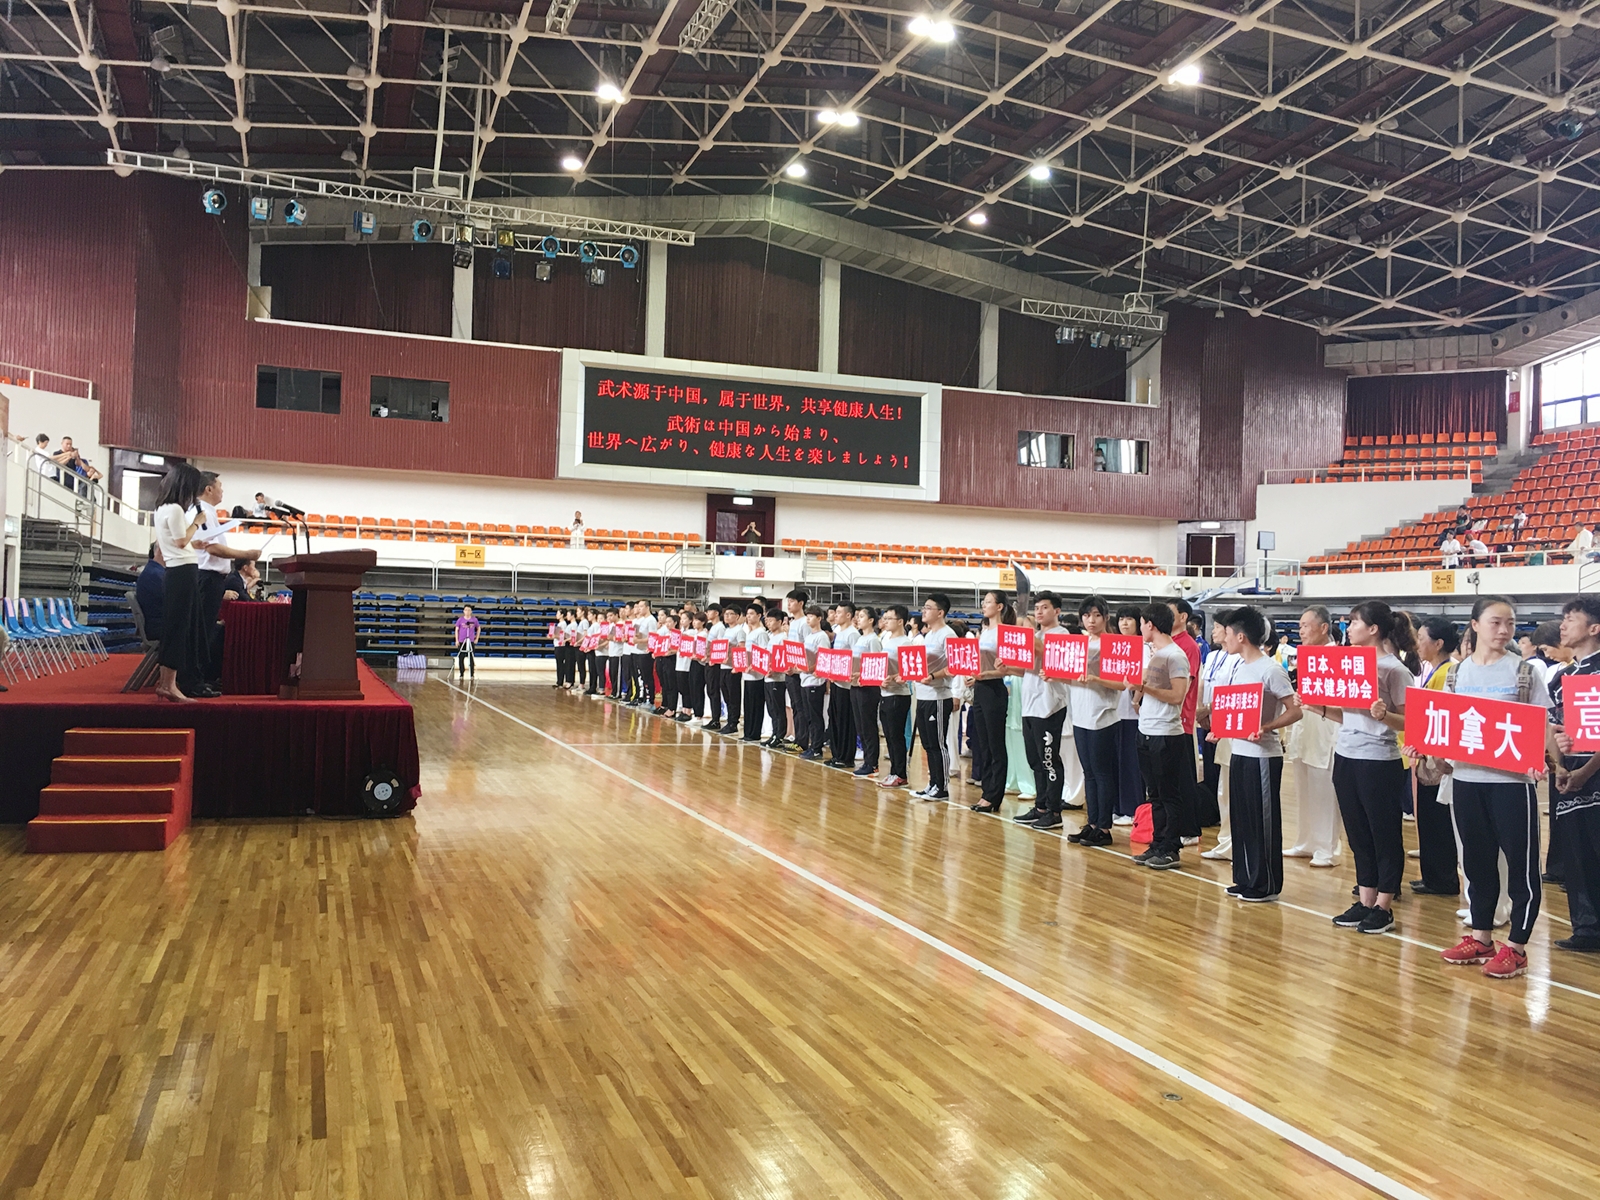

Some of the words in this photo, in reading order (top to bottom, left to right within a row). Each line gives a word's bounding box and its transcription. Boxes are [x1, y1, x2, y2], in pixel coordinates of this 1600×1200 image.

[667, 415, 839, 444] 武術は中国から始まり、
[460, 549, 481, 559] 西一区
[1434, 574, 1452, 584] 北一区
[1111, 641, 1132, 657] スタジオ
[1307, 655, 1366, 676] 日本、中国
[1301, 677, 1373, 700] 武术健身协会
[1424, 701, 1522, 761] 加拿大
